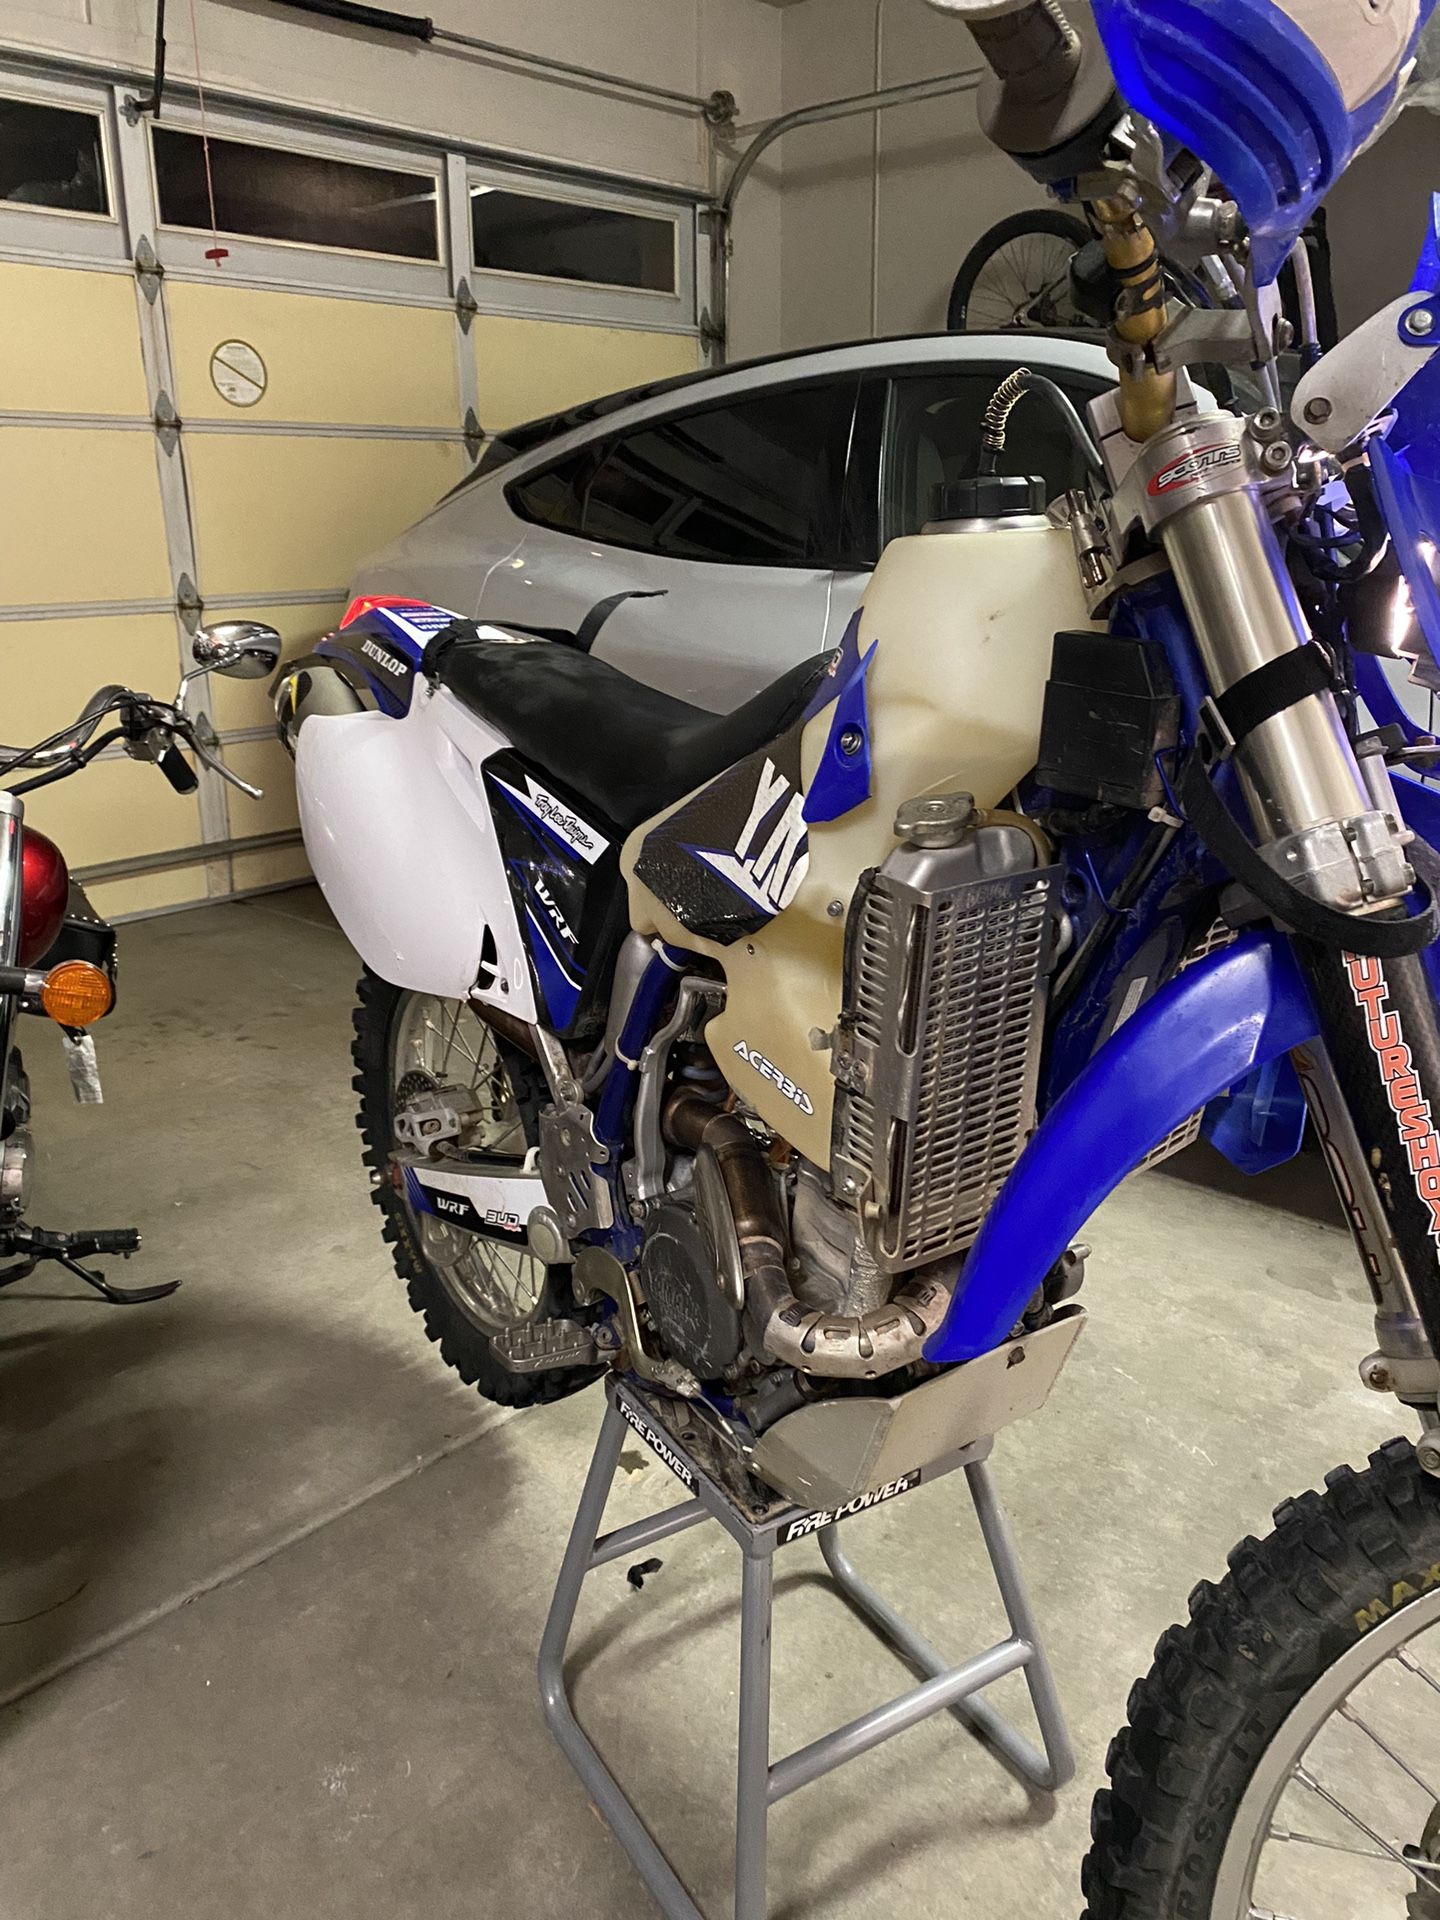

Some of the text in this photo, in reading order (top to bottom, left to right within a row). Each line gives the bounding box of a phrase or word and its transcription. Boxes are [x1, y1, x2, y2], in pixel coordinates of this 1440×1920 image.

[361, 639, 408, 677] DUNLOP
[534, 872, 580, 944] WRF
[436, 1196, 470, 1216] WRF
[645, 1429, 693, 1485] POWER
